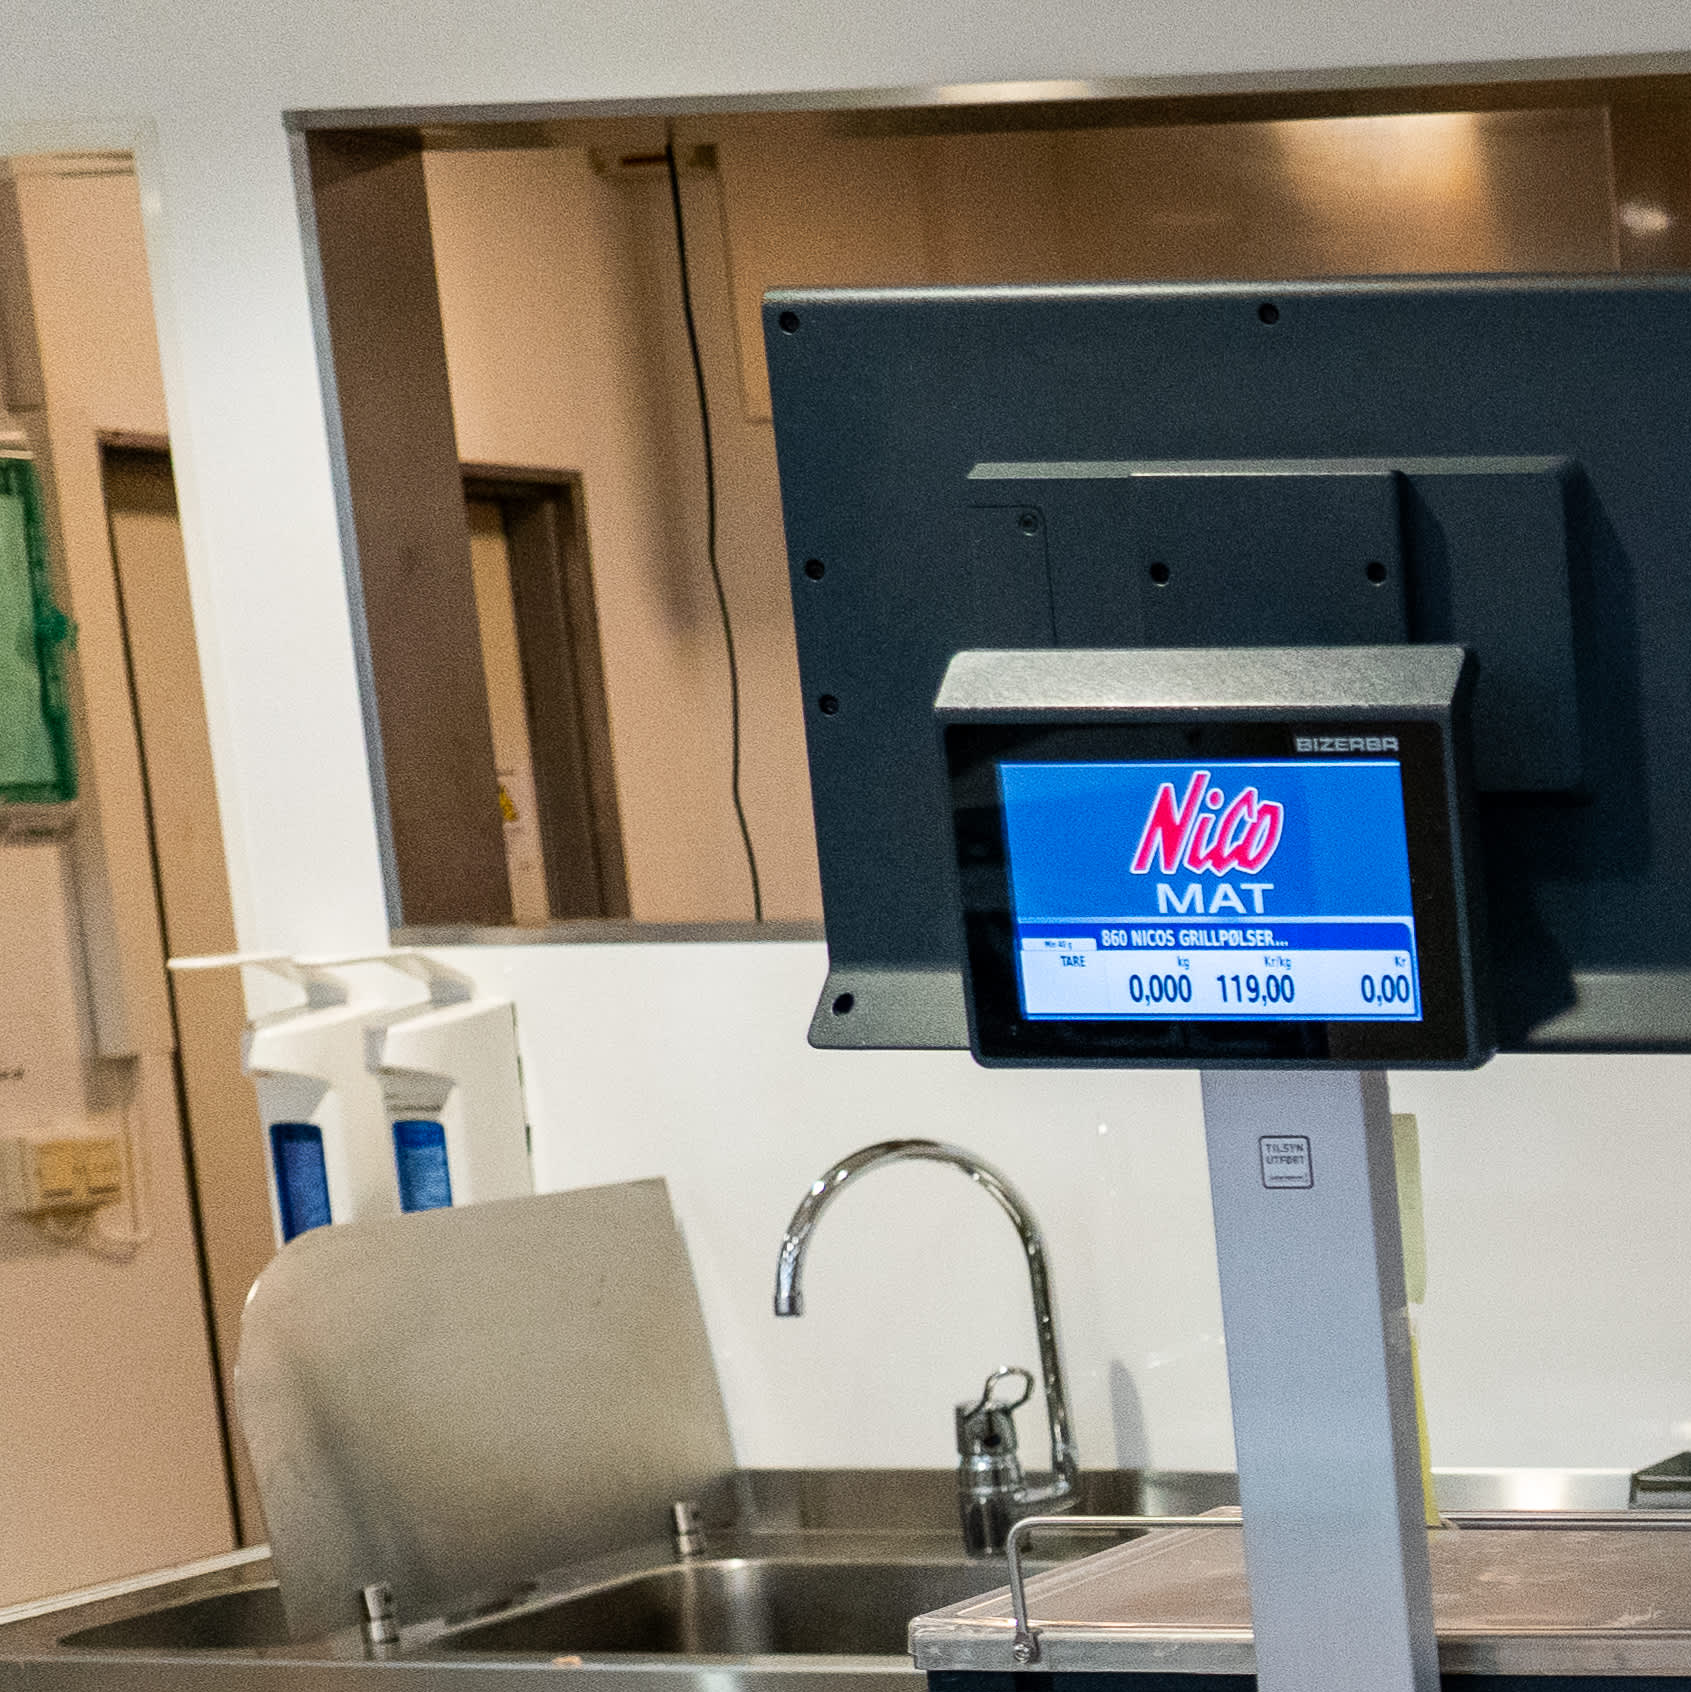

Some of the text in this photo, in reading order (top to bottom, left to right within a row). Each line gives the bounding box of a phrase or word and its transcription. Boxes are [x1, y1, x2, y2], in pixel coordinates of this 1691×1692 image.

[1296, 737, 1399, 751] BIZERBA
[1157, 883, 1274, 914] MAT
[1102, 929, 1289, 947] 860 NICOS GRILLPØLSER...
[1060, 955, 1086, 967] TARE
[1177, 955, 1190, 970] kg
[1263, 955, 1292, 970] Kr/kg
[1394, 956, 1407, 968] Kr
[1129, 974, 1192, 1005] 0,000
[1216, 974, 1295, 1005] 119,00
[1360, 974, 1410, 1005] 0,00
